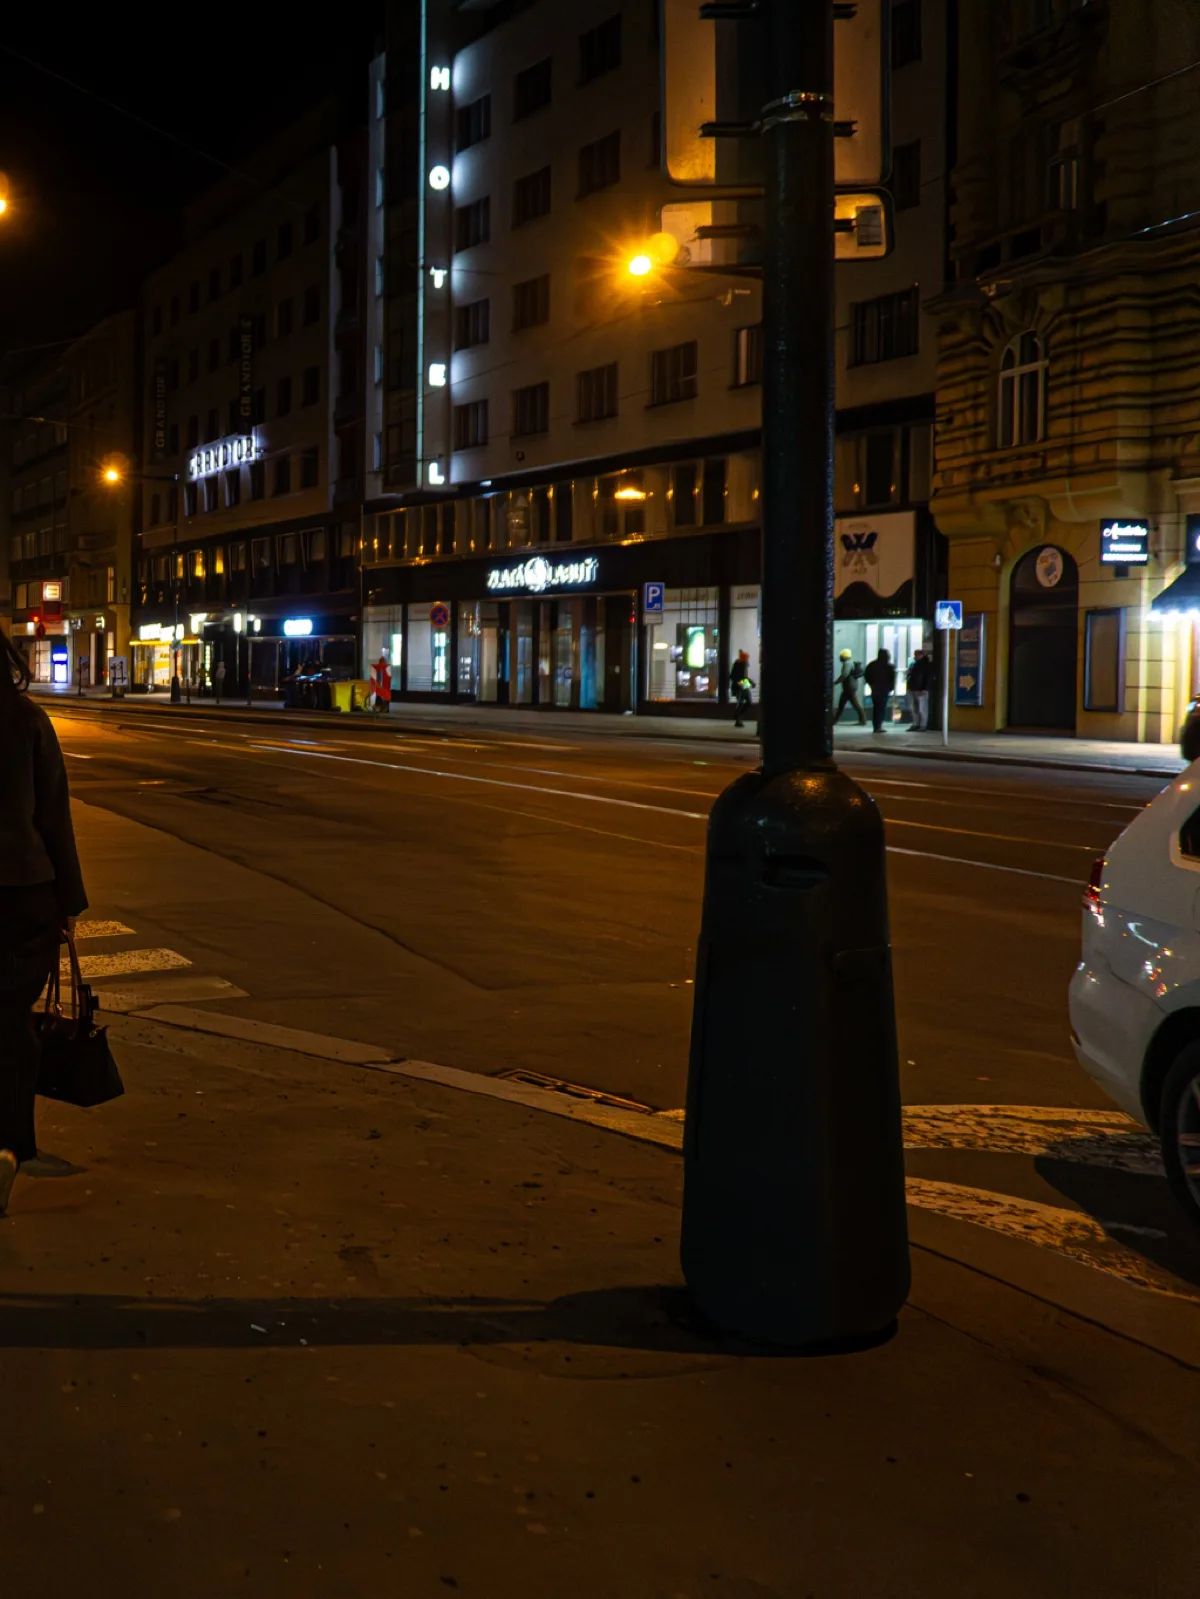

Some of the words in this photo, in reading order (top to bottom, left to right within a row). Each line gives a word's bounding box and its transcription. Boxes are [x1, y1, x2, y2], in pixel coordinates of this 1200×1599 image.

[428, 66, 450, 485] HOTEL
[188, 436, 253, 476] GRANDIOR
[648, 586, 661, 603] P
